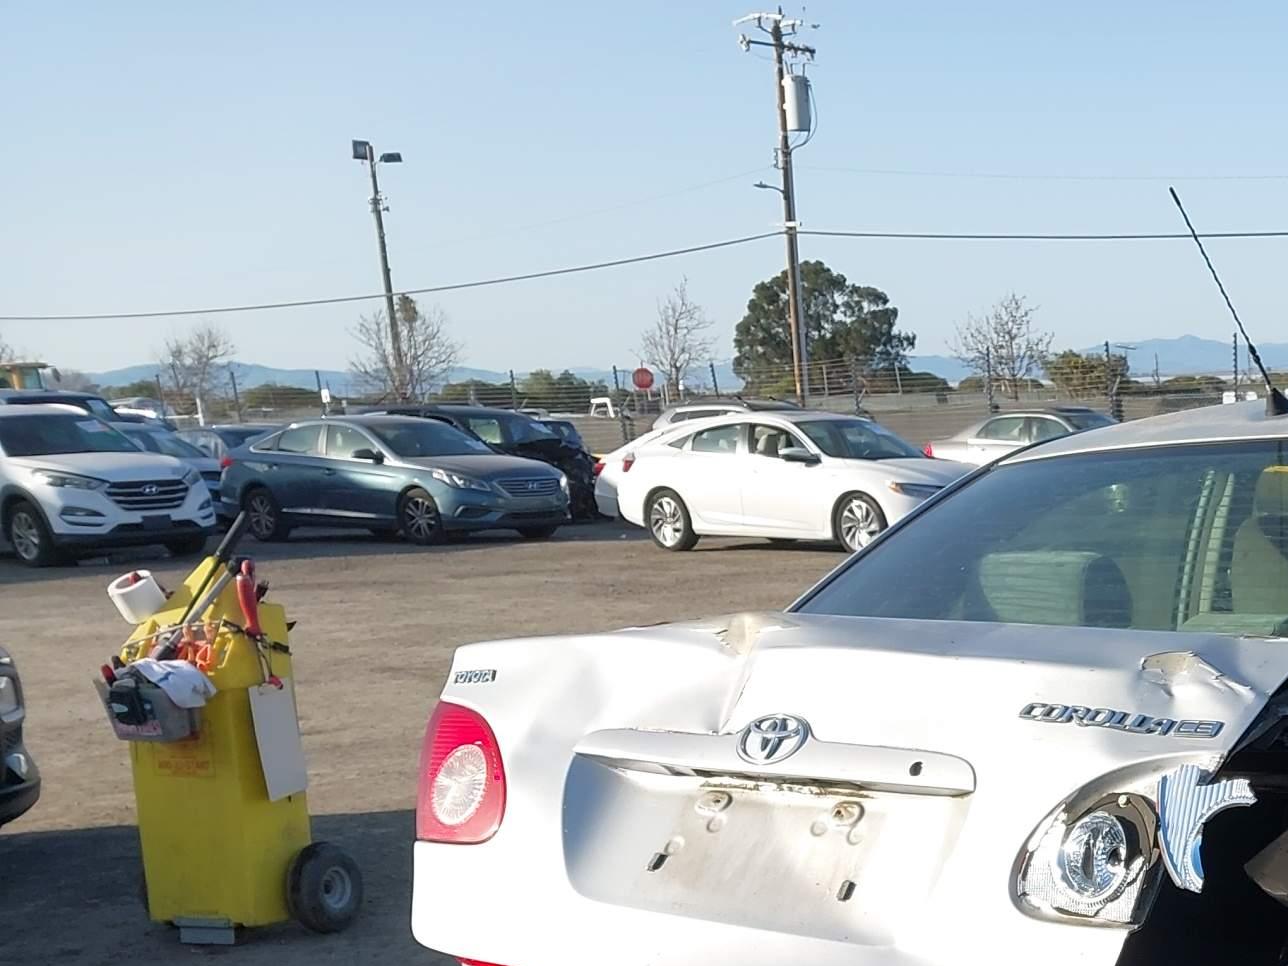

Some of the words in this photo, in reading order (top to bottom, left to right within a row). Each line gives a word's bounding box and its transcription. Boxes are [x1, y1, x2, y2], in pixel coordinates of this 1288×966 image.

[454, 669, 497, 684] TOYOTA
[1019, 702, 1178, 736] COROLLA
[1174, 719, 1227, 739] CE
